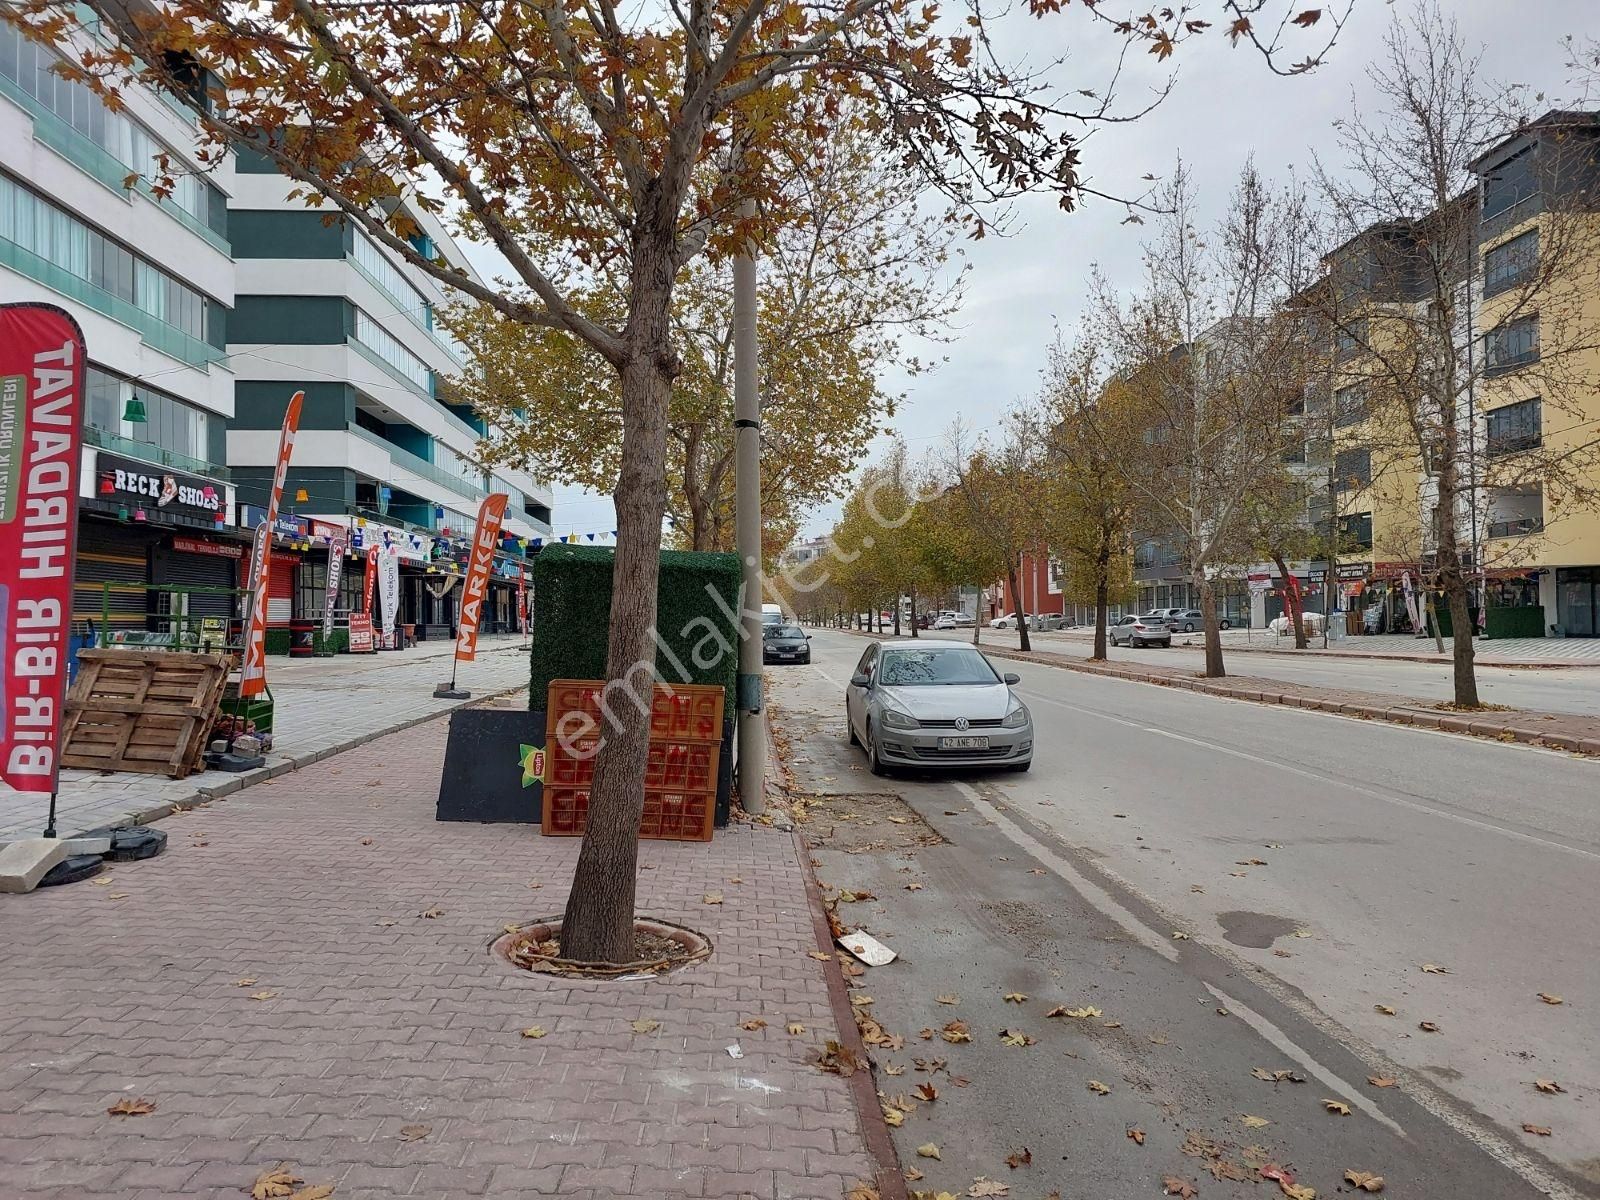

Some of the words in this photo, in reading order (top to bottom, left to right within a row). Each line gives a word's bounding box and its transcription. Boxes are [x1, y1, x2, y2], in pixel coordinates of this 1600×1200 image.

[114, 468, 160, 498] RECK
[178, 485, 219, 511] SHOES
[458, 507, 500, 653] MARKET
